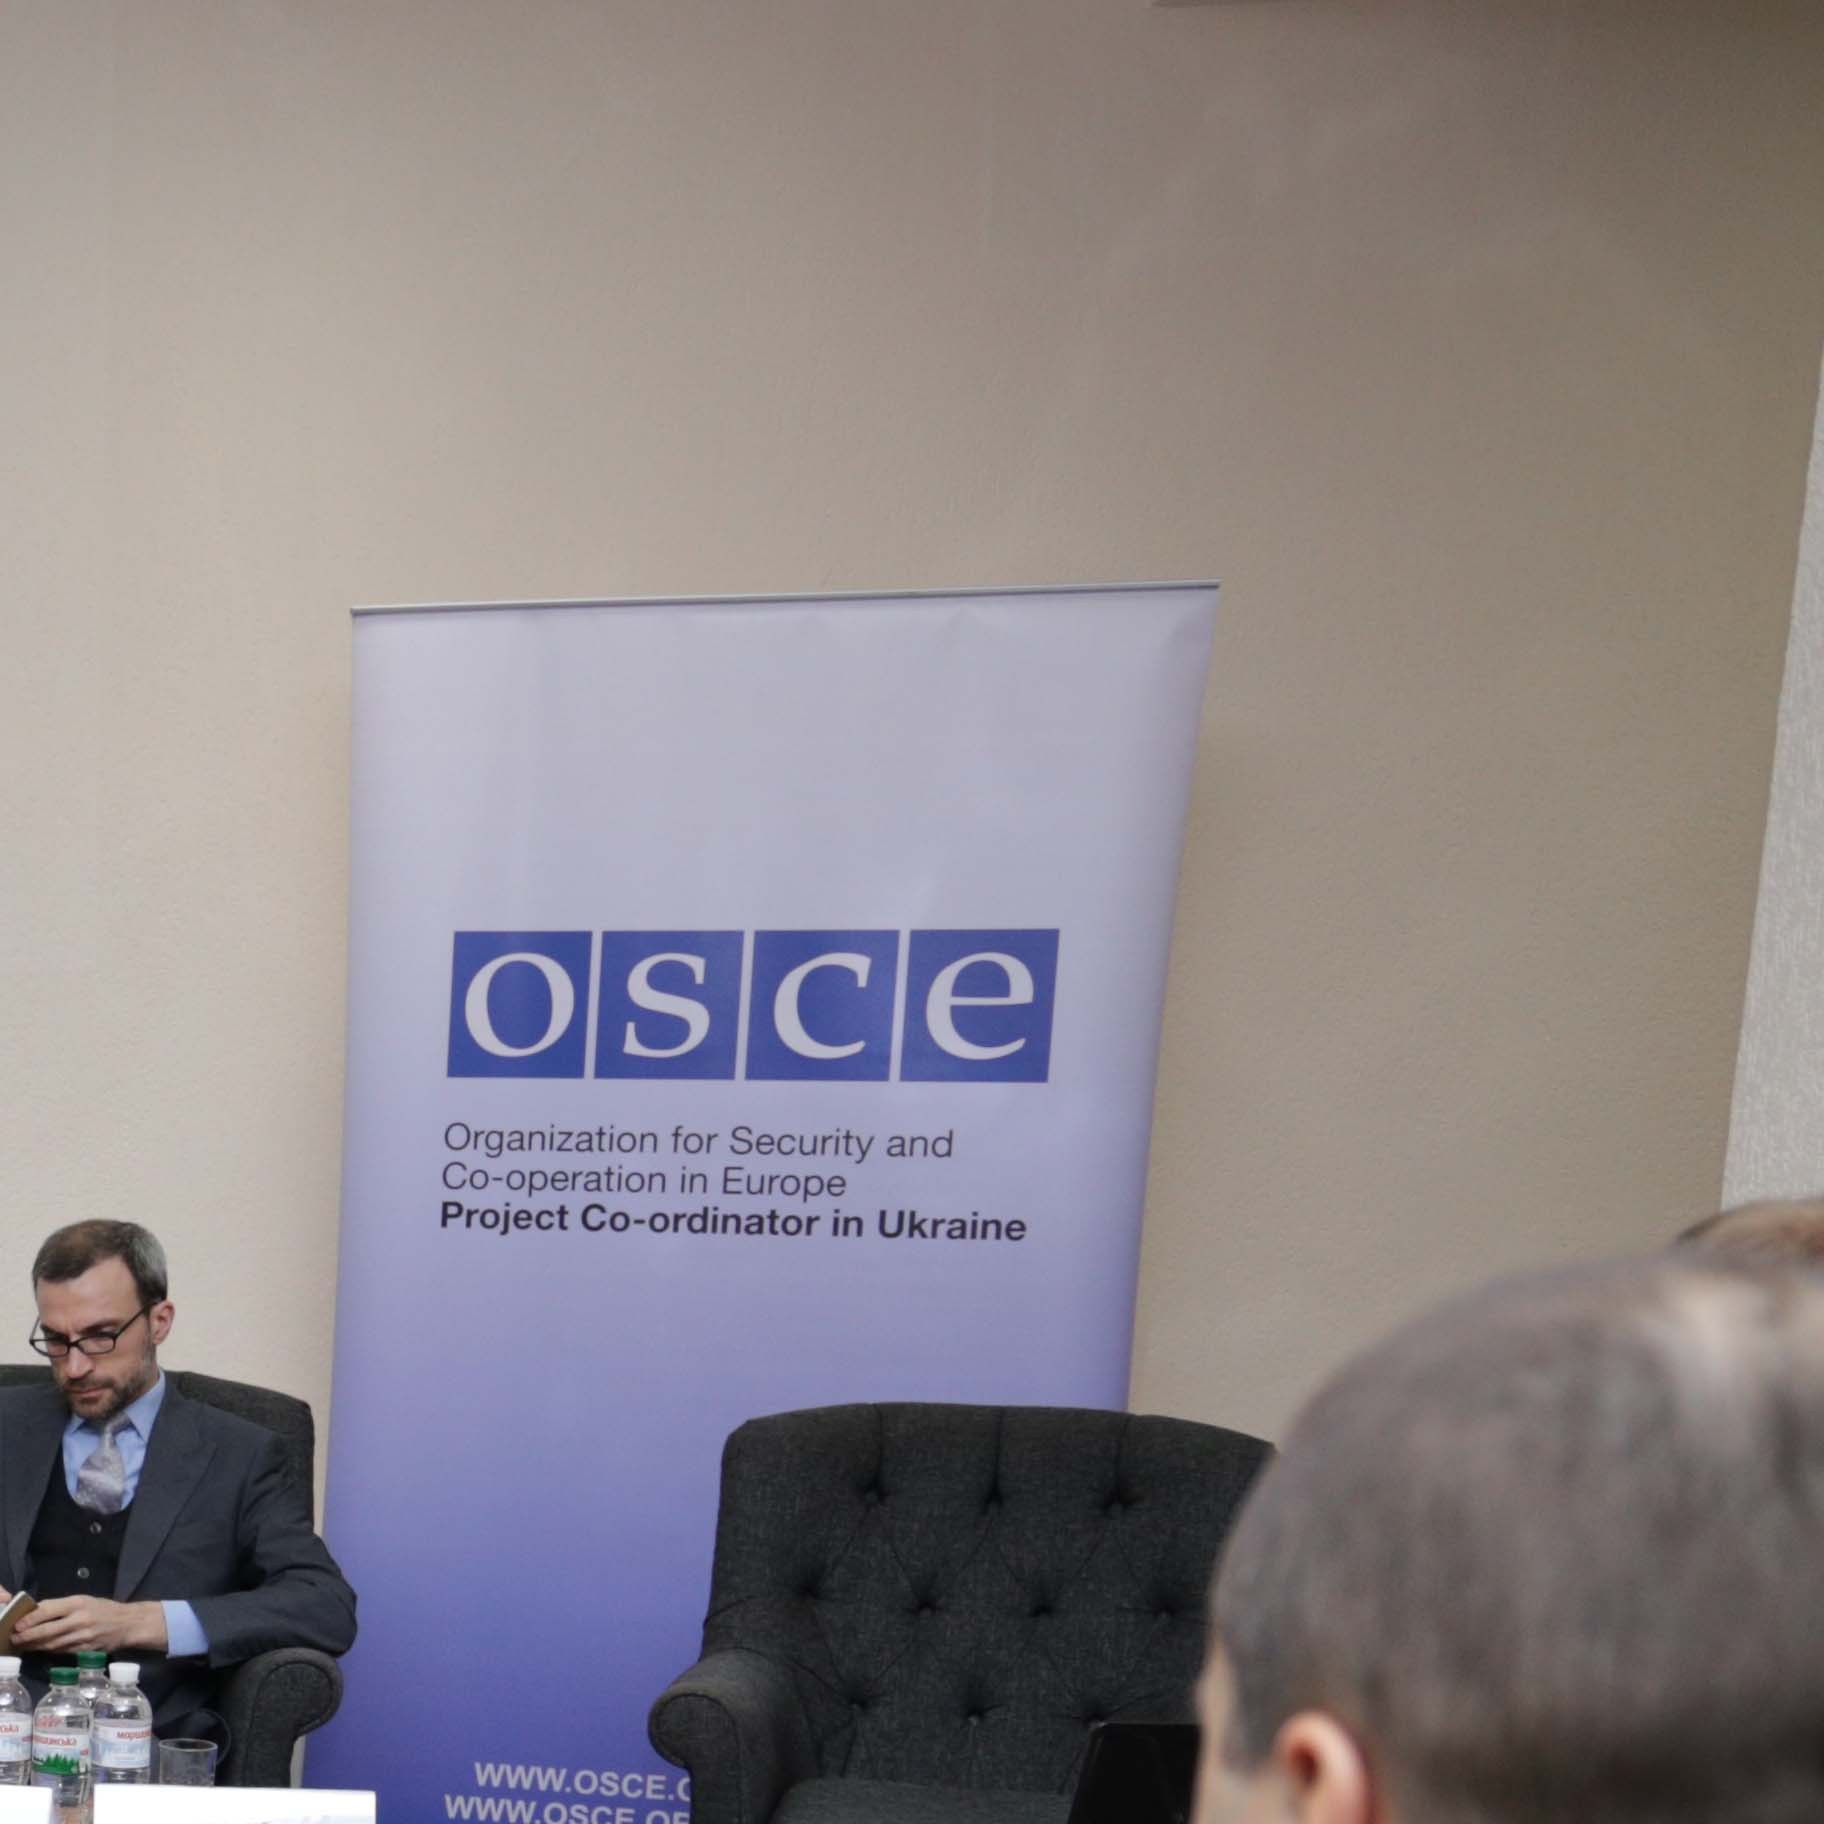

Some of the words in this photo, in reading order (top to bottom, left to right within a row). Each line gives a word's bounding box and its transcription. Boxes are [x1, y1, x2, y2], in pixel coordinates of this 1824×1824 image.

[444, 1121, 659, 1159] Organization
[671, 1124, 719, 1154] for
[728, 1125, 875, 1165] Security
[885, 1128, 955, 1158] and
[441, 1161, 667, 1199] Co-operation
[679, 1165, 708, 1195] in
[722, 1165, 847, 1203] Europe
[440, 1200, 569, 1236] Project
[580, 1203, 821, 1237] Co-ordinator
[831, 1208, 865, 1238] in
[877, 1209, 1028, 1241] Ukraine
[474, 1761, 692, 1803] WWW.OSCE.O
